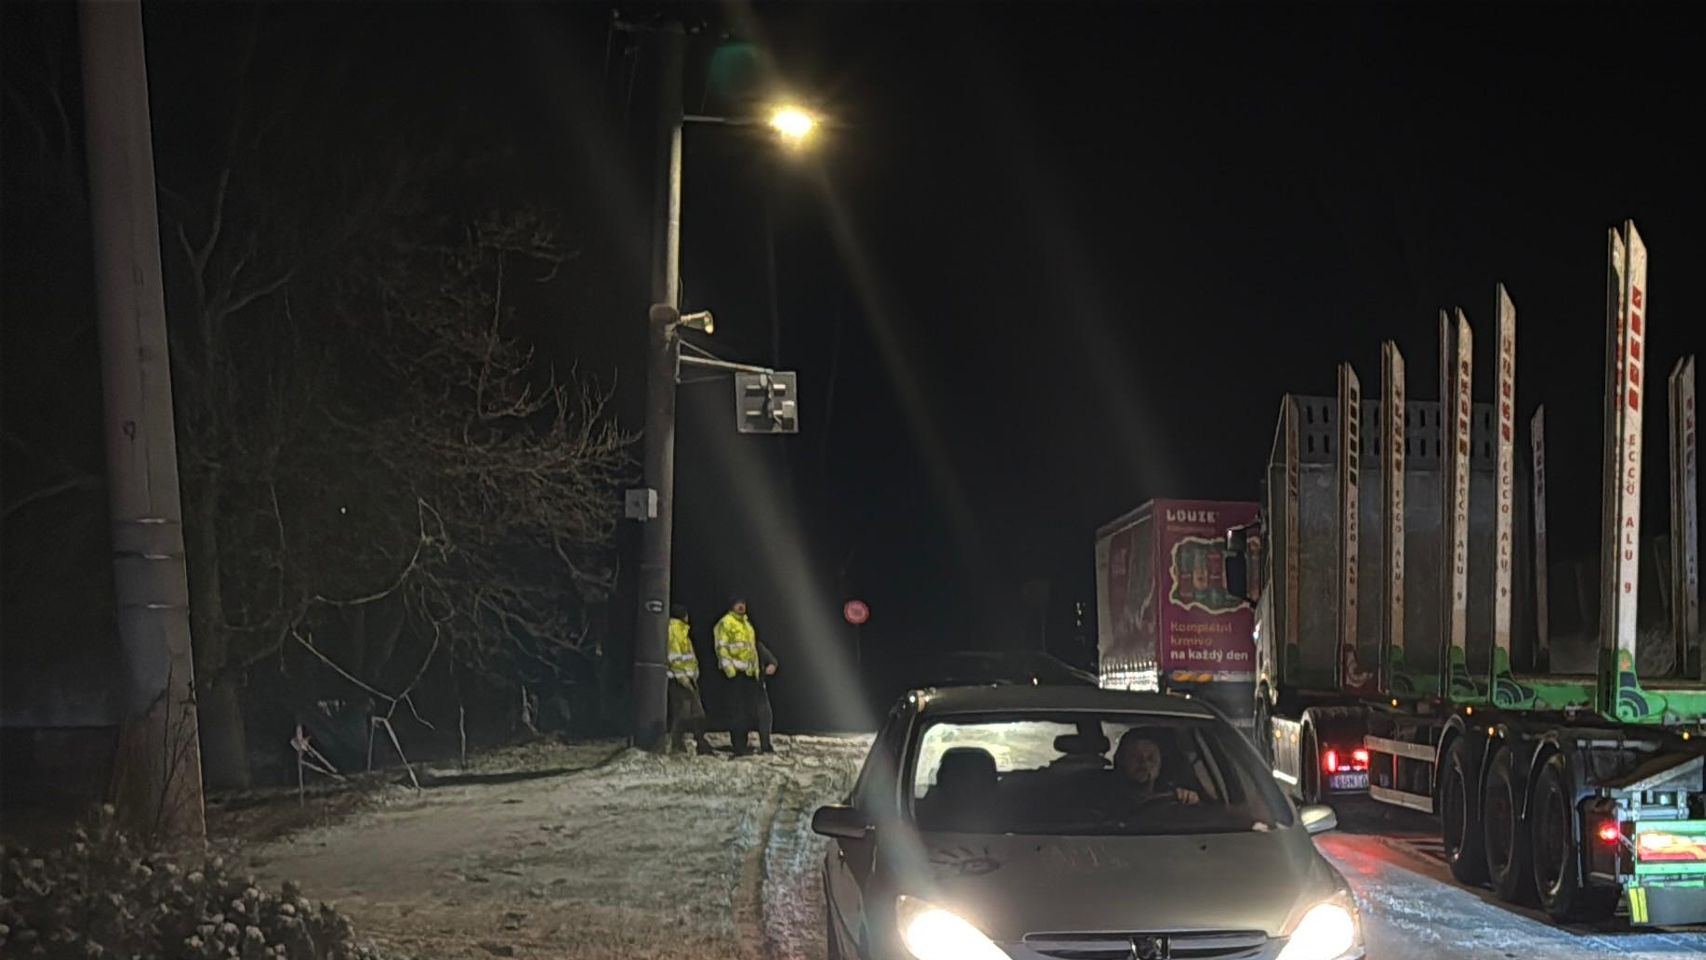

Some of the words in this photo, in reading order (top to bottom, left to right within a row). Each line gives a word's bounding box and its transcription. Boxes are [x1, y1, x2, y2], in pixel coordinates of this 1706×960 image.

[1626, 434, 1636, 495] ECCO
[1500, 532, 1509, 570] ALU
[1625, 517, 1635, 560] ALU
[1456, 540, 1465, 575] ALU
[1624, 582, 1632, 593] 9
[1170, 651, 1185, 661] na
[1188, 649, 1223, 664] každý
[1226, 650, 1249, 661] den
